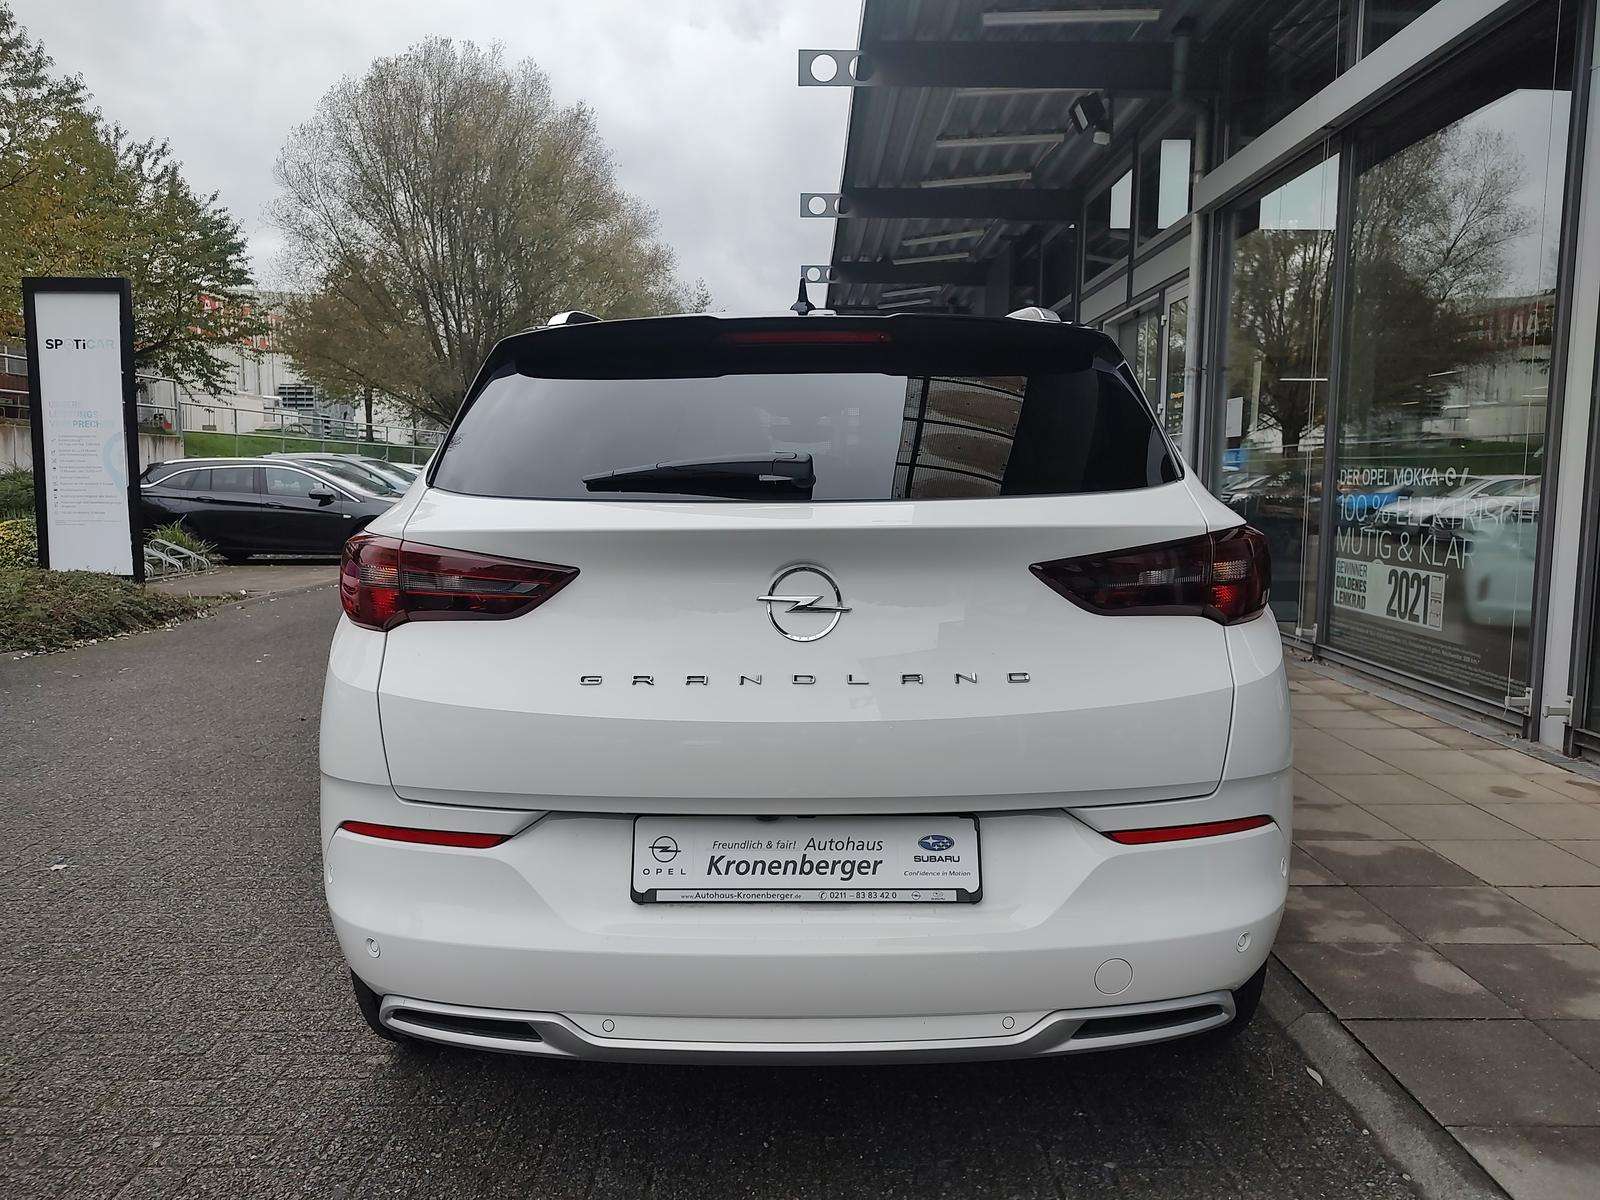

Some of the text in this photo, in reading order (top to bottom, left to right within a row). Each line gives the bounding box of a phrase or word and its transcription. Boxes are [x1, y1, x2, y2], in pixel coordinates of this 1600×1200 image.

[1339, 469, 1360, 486] DER
[1362, 468, 1390, 486] OPEL
[1339, 494, 1368, 522] 100
[1372, 495, 1391, 524] %
[1336, 526, 1392, 559] MUTIG
[1397, 531, 1413, 562] &
[1336, 575, 1368, 594] GOLDENES
[1335, 590, 1367, 610] LENKRAD
[1386, 568, 1431, 625] 2021
[579, 671, 1032, 687] GRANDLAND
[712, 836, 884, 852] Freundlich & fair! Autohaus
[706, 854, 884, 882] Kronenberger
[913, 855, 961, 863] SUBARU
[642, 868, 687, 876] OPEL
[829, 891, 848, 900] 0211
[855, 891, 866, 900] 83
[867, 891, 878, 900] 83
[879, 891, 890, 900] 42
[891, 891, 898, 900] 0
